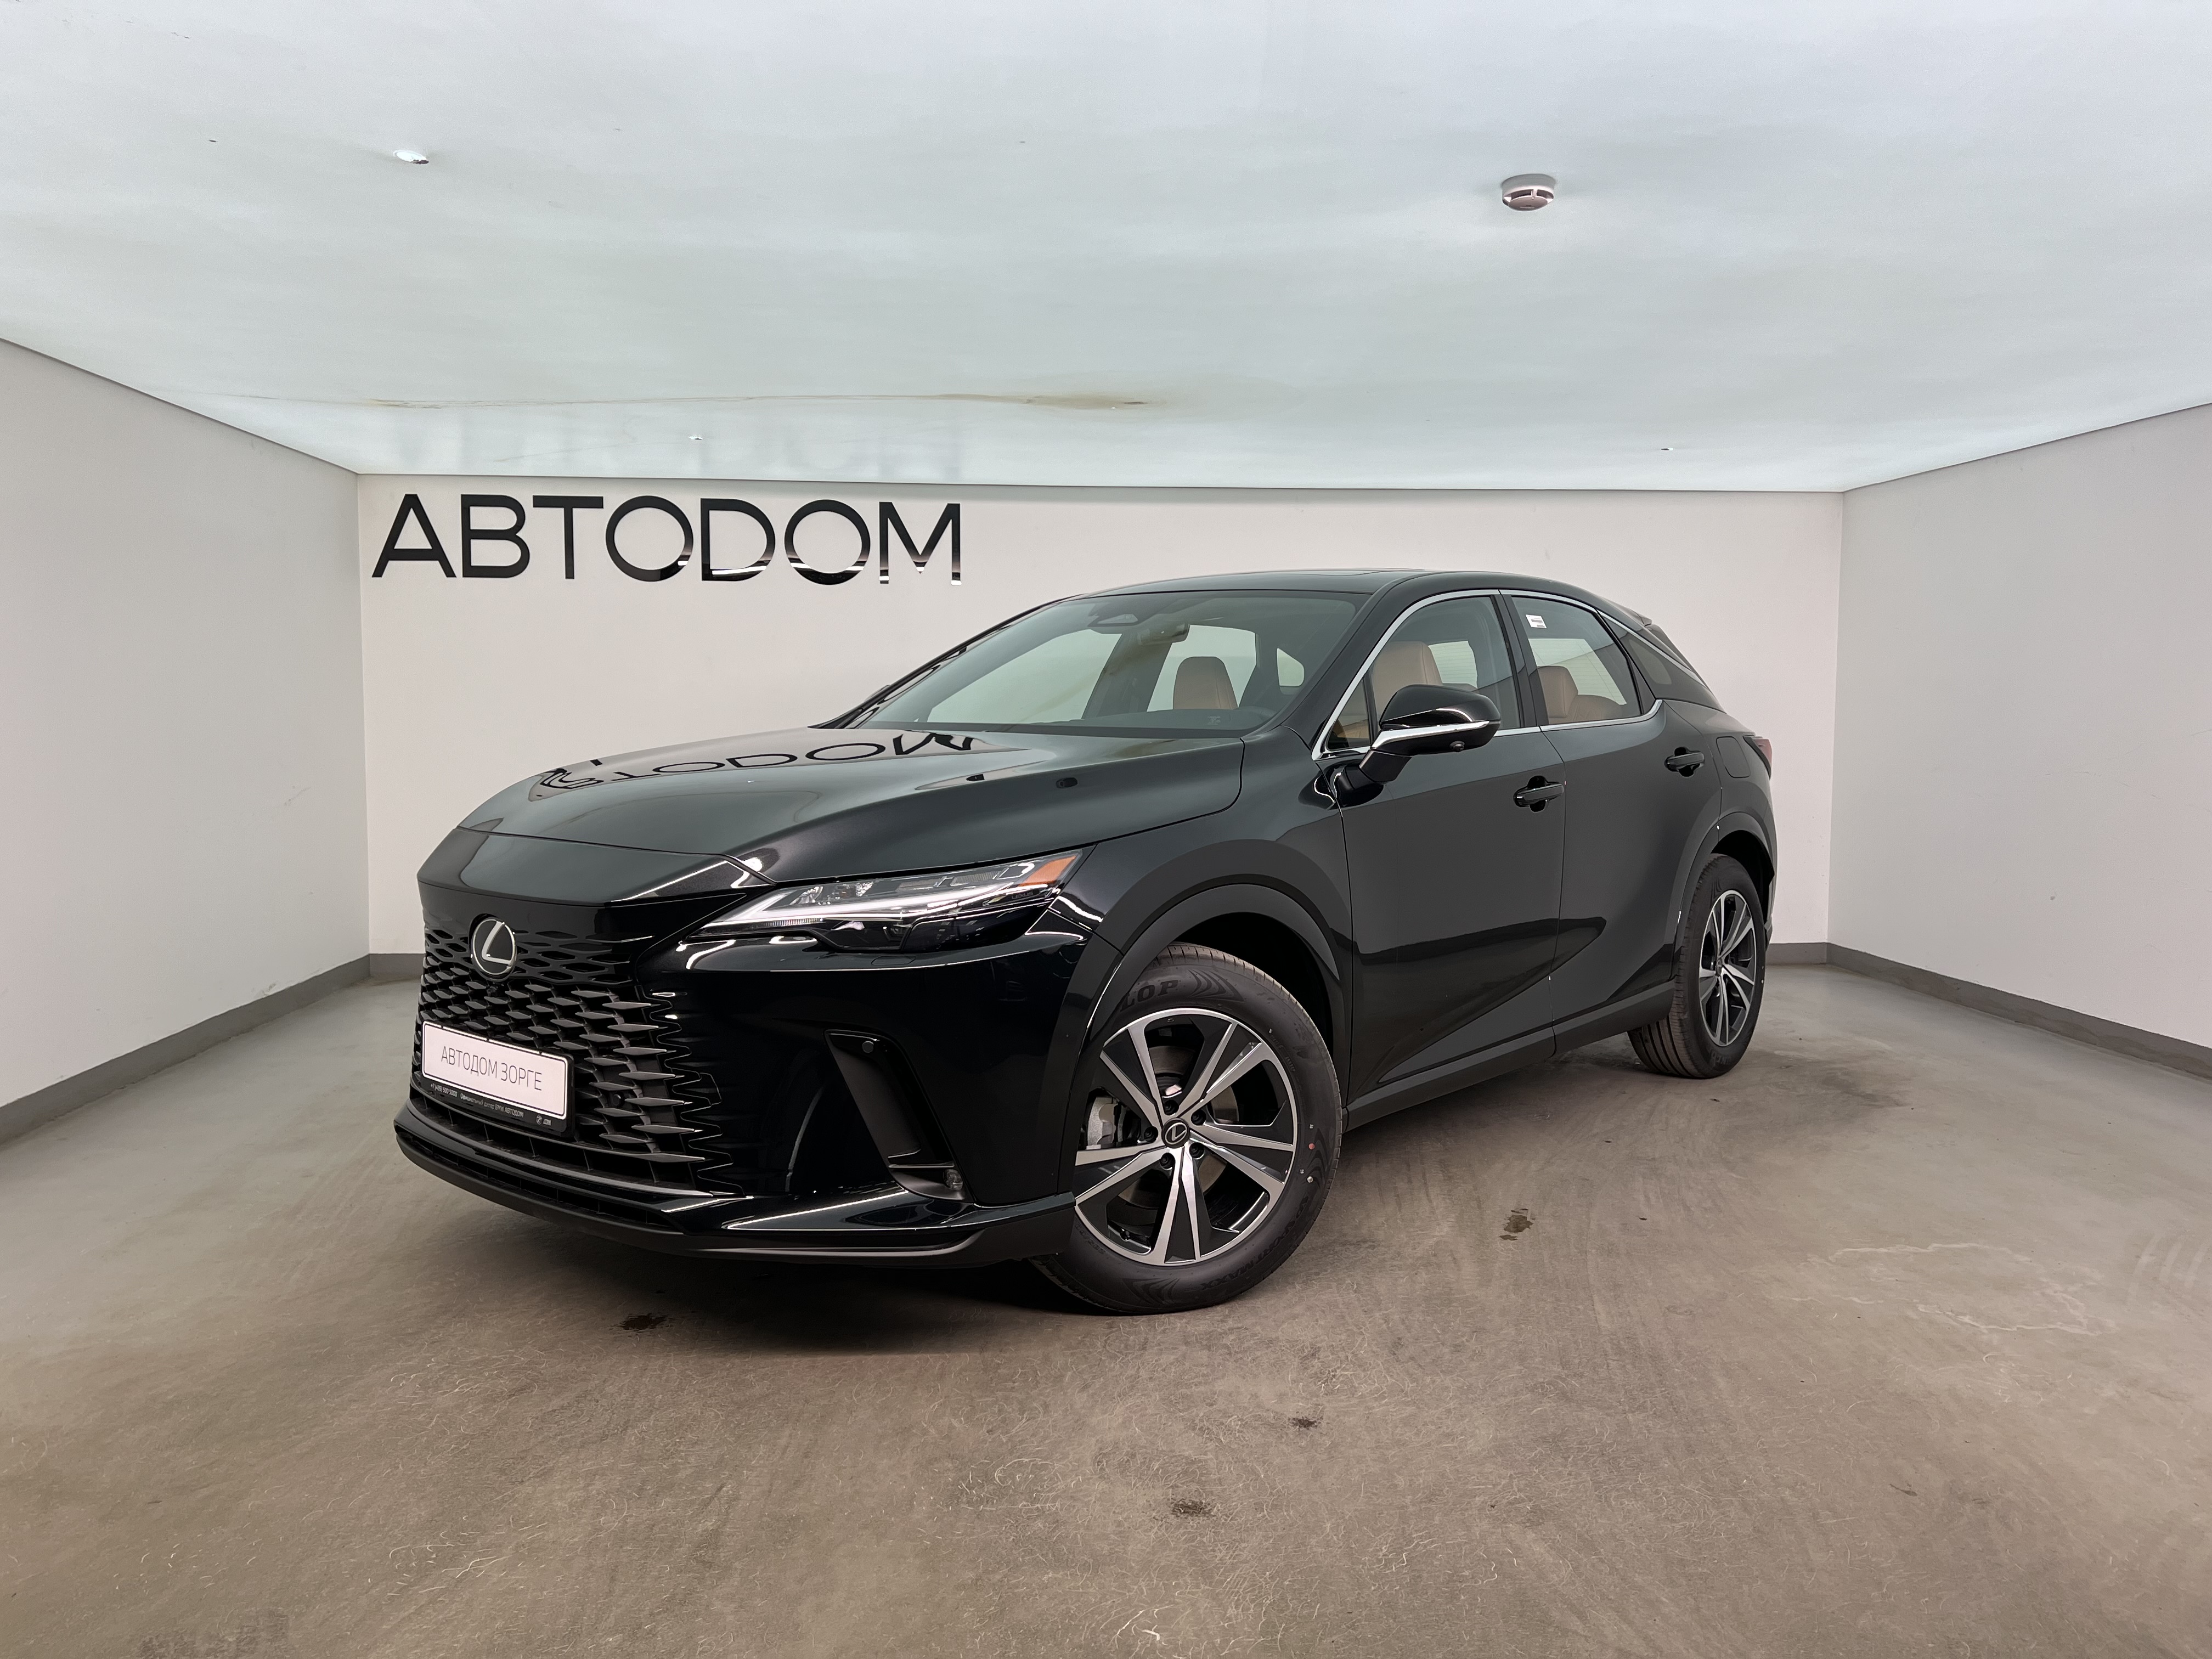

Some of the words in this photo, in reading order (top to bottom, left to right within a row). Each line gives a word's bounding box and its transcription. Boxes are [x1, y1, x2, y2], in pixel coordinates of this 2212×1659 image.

[1120, 980, 1178, 1012] LOP
[441, 1046, 499, 1079] АВТОДОМ
[500, 1062, 543, 1091] ЗОРГЕ
